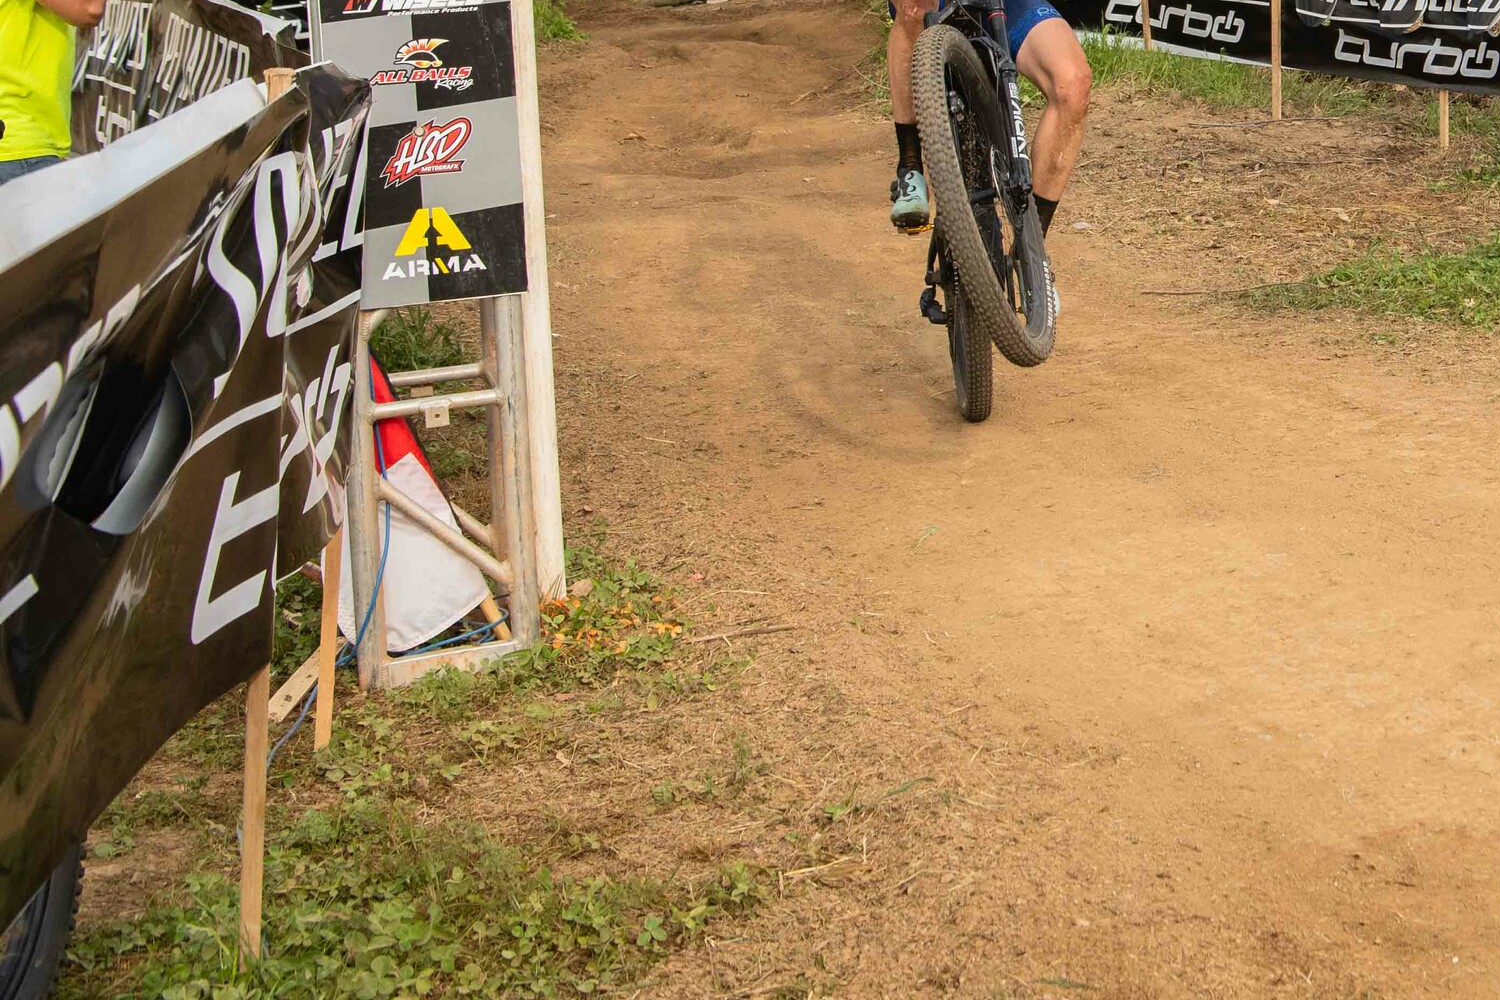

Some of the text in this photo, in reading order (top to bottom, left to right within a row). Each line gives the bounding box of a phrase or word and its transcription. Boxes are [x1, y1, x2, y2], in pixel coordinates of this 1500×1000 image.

[387, 6, 479, 17] Performance Products
[1335, 28, 1500, 79] turbo
[370, 66, 473, 85] ALL BALLS
[434, 78, 474, 91] Racing
[420, 163, 460, 172] MOTOGRAFX
[381, 254, 488, 280] ARMA
